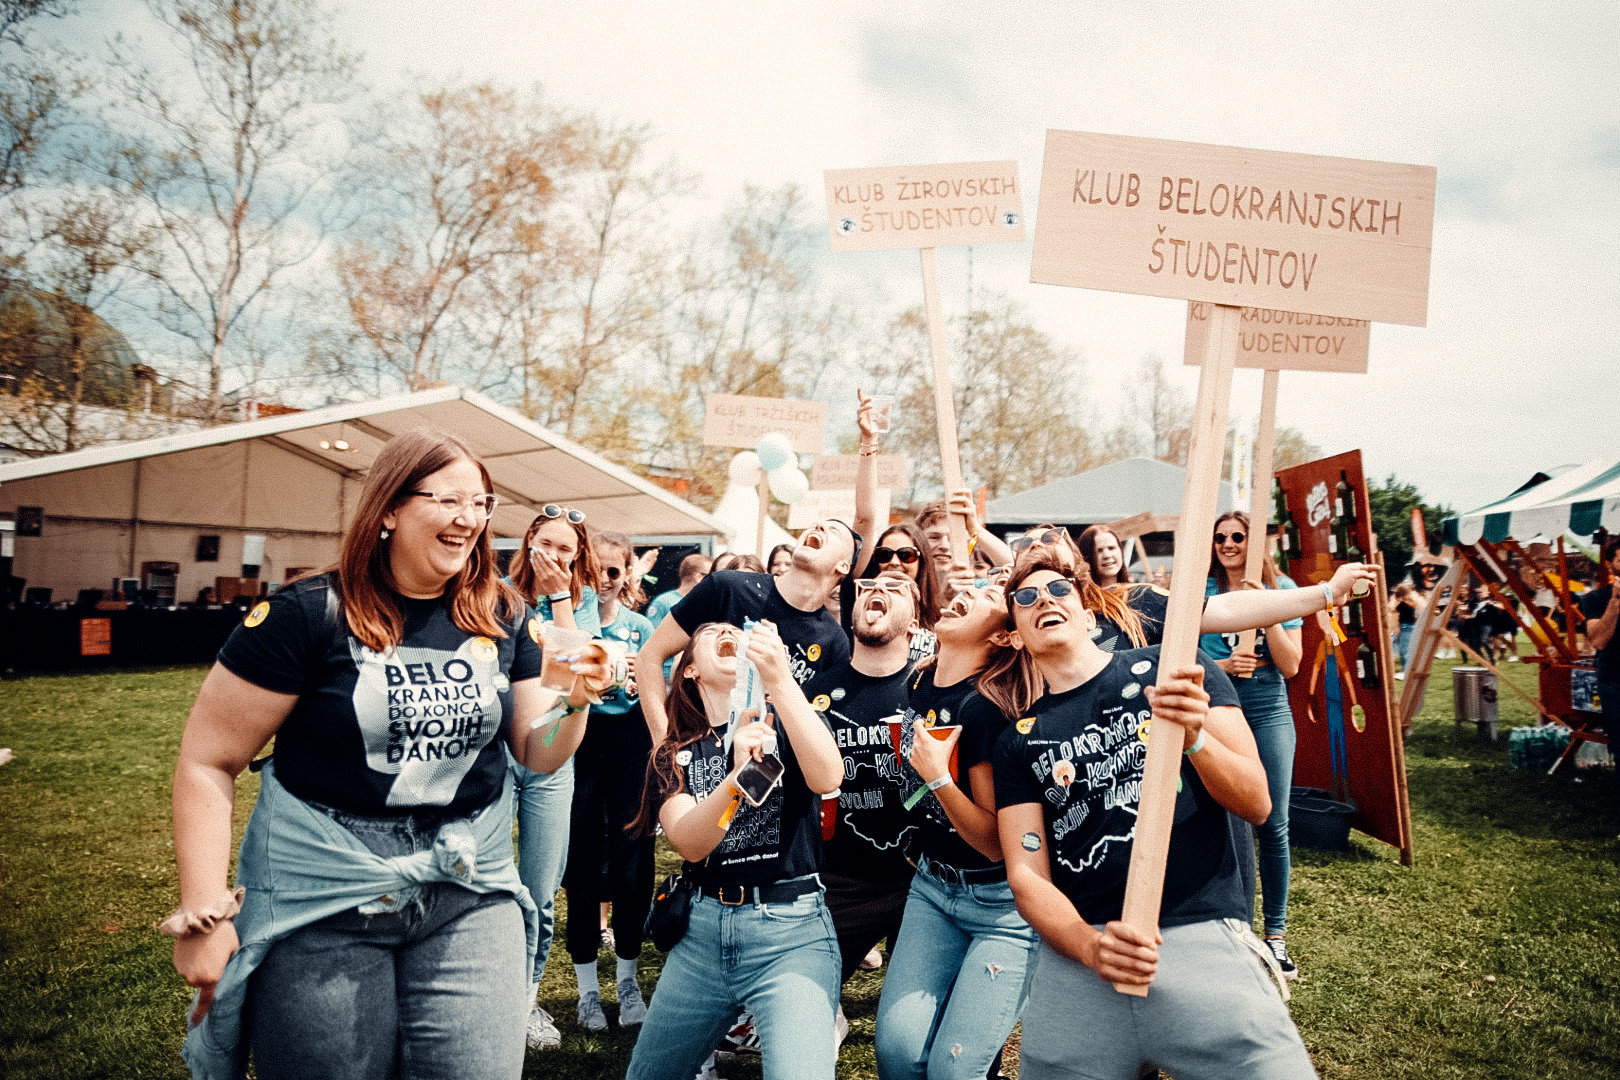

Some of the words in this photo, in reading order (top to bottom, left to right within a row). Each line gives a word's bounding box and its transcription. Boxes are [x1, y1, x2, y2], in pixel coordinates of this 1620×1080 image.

[834, 183, 885, 204] KLUB
[897, 176, 1016, 201] ŽIROVSKIH
[1073, 168, 1141, 207] KLUB
[1159, 176, 1402, 235] BELOKRANJSKIH
[861, 205, 998, 233] ŠTUDENTOV
[1149, 223, 1318, 291] ŠTUDENTOV
[1239, 332, 1346, 355] UDENTOV
[385, 659, 473, 687] BELO
[388, 683, 481, 705] KRANJCI
[388, 705, 417, 721] DO
[423, 702, 483, 718] KONCA
[388, 715, 484, 743] SVOJIH
[387, 737, 481, 764] DANOF
[1031, 710, 1151, 783] BELOKRANJC
[1086, 744, 1147, 779] KONC
[839, 790, 884, 809] SVOJIH
[1104, 780, 1143, 810] DAN
